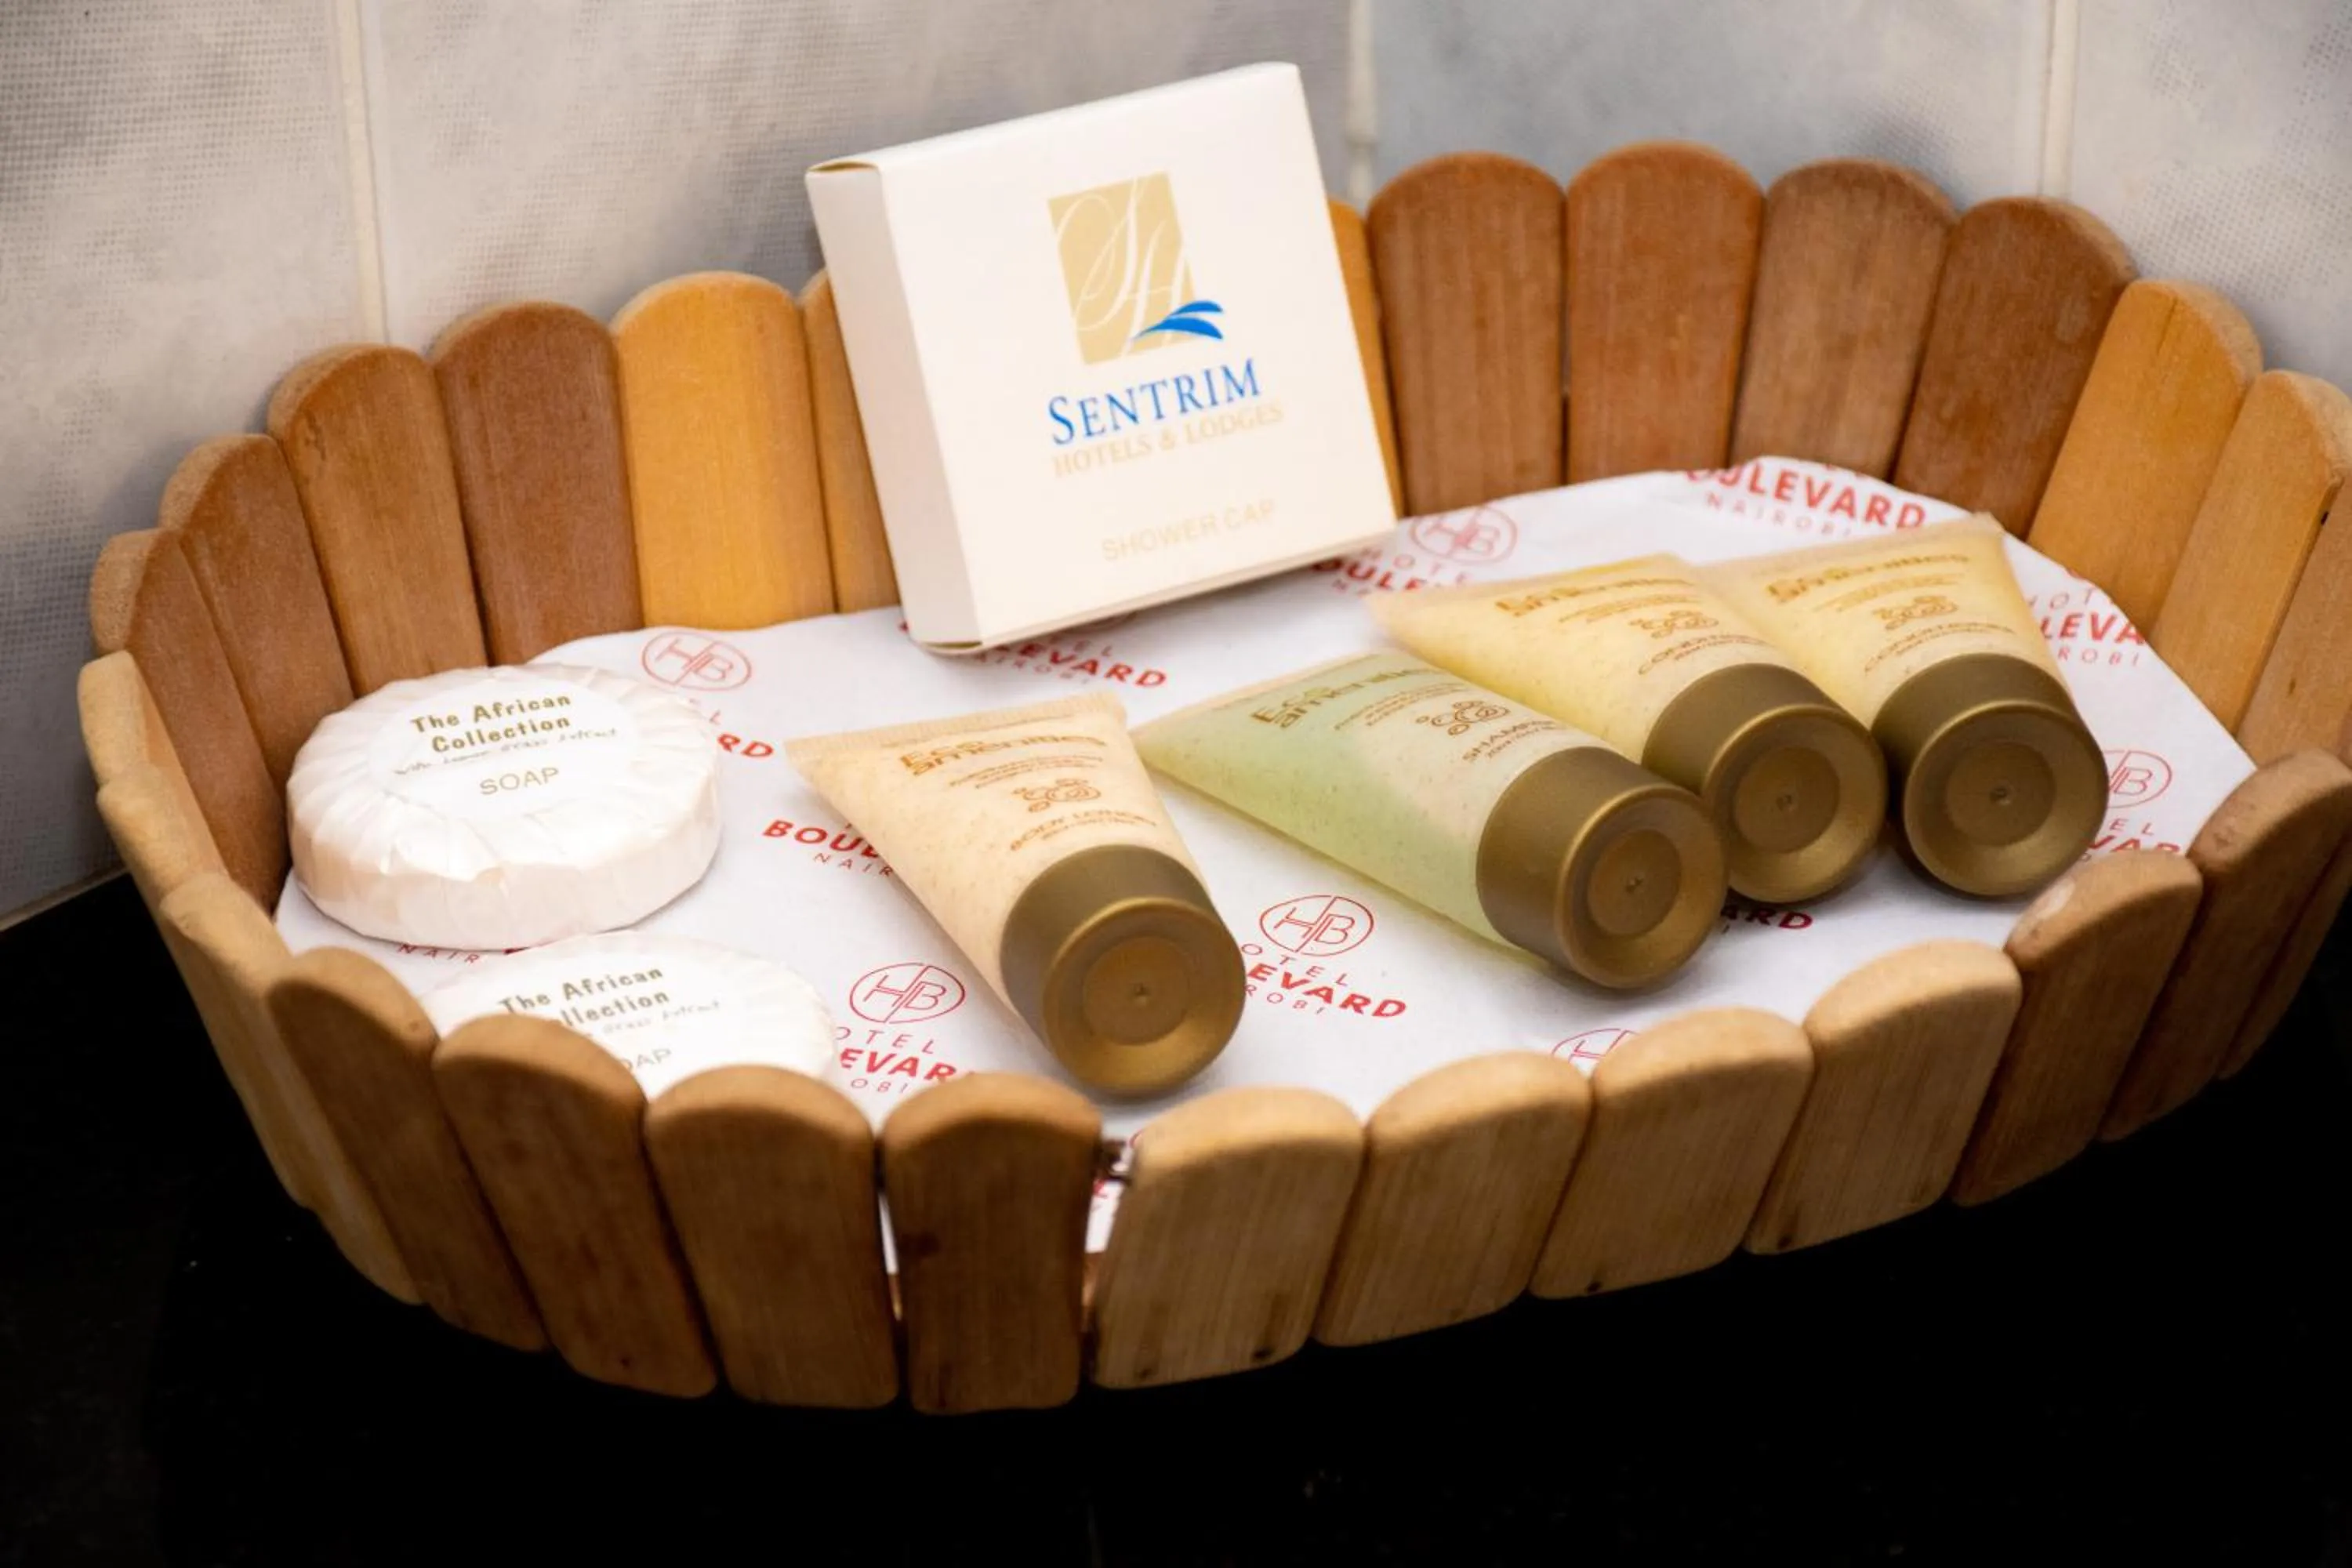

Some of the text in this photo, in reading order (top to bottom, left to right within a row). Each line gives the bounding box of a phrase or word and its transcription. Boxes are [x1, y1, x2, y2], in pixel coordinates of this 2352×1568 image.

[1047, 357, 1261, 446] SENTRIM
[1052, 401, 1285, 477] HOTELS & LODGES
[1686, 459, 1926, 530] ULEVARD
[1101, 498, 1275, 562] SHOWER CAP
[1017, 641, 1167, 688] EVARD
[2057, 645, 2140, 668] ROBI
[410, 693, 572, 734] The African
[431, 715, 571, 753] Collection
[479, 766, 559, 796] SOAP
[812, 851, 894, 877] NAIR
[397, 942, 481, 964] NAIR
[1241, 943, 1348, 987] OTEL
[498, 964, 664, 1014] The African
[561, 988, 670, 1029] llection
[1244, 983, 1326, 1015] ROBI
[1247, 963, 1407, 1018] EVARD
[835, 1026, 936, 1054] OTEL
